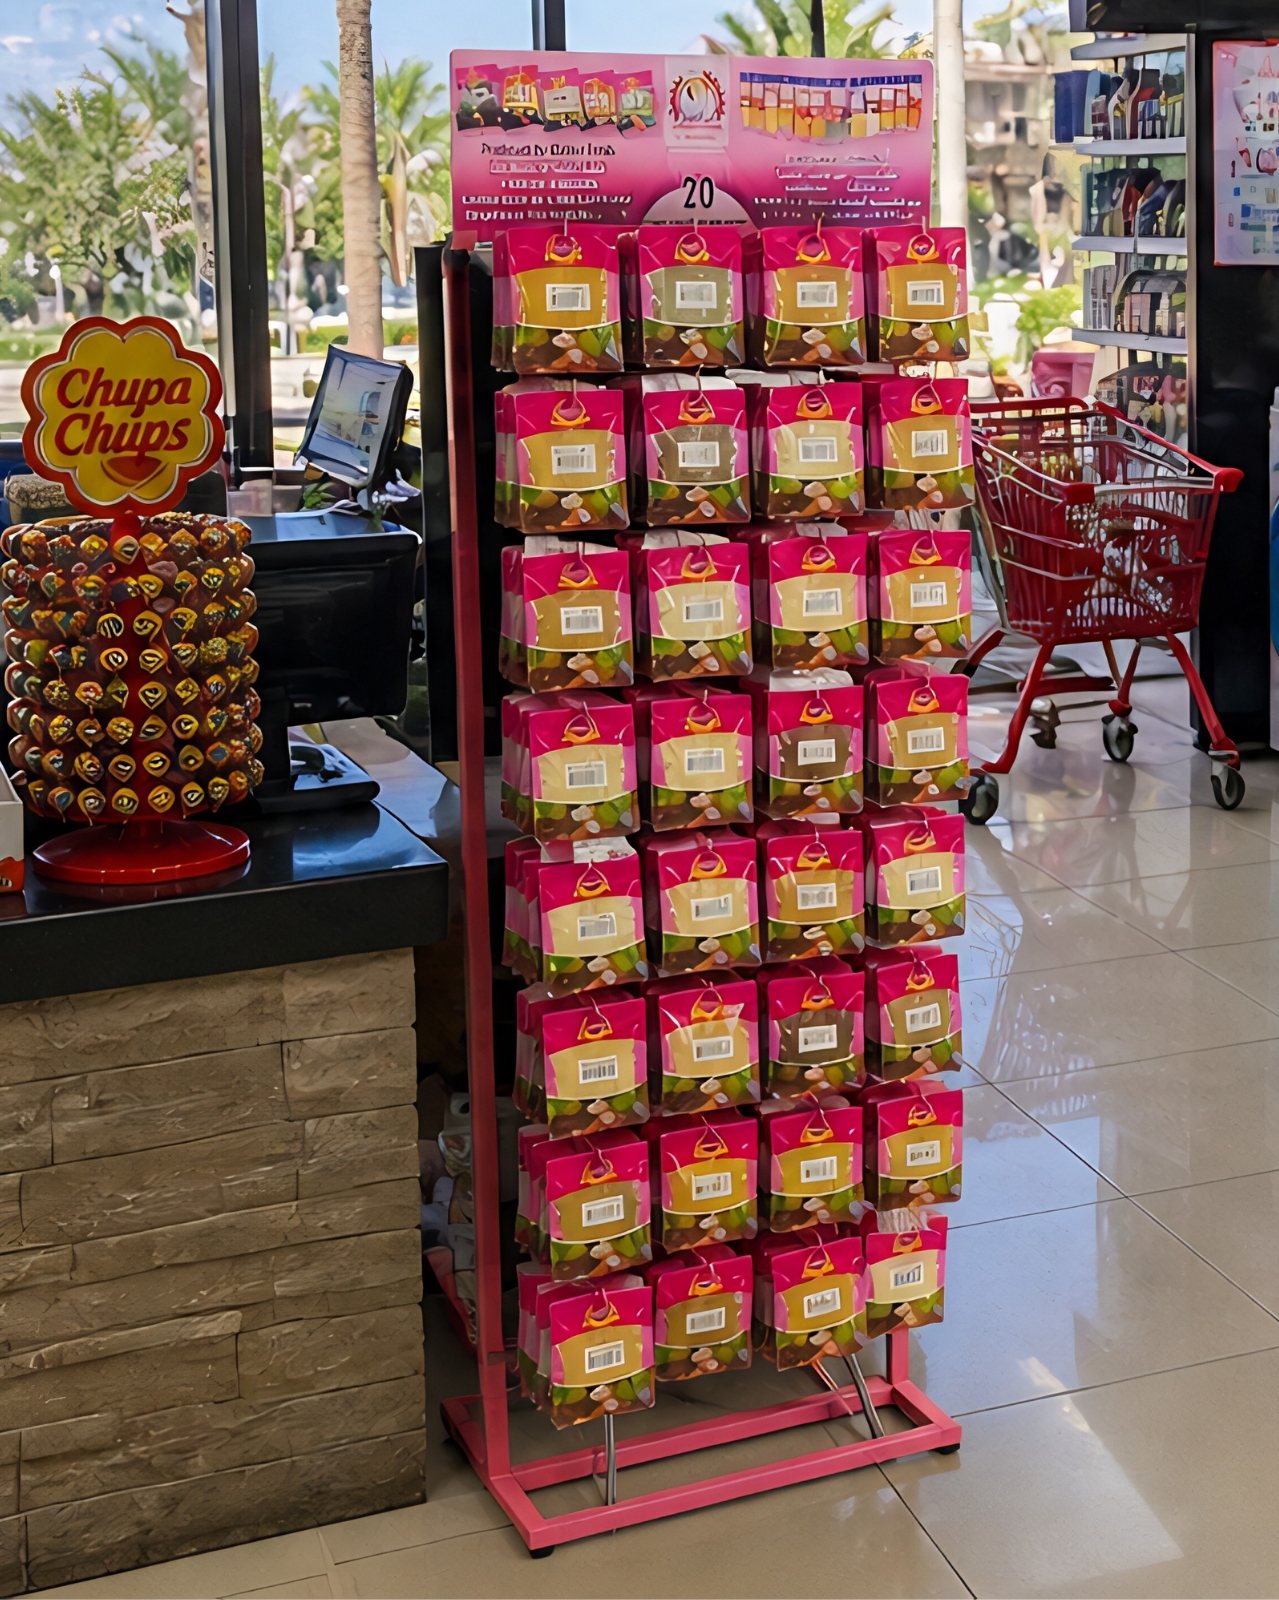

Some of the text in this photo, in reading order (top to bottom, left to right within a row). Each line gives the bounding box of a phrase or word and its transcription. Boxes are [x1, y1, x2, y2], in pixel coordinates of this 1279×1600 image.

[683, 176, 714, 209] 20
[56, 367, 192, 418] Chupa
[55, 411, 191, 465] Chups
